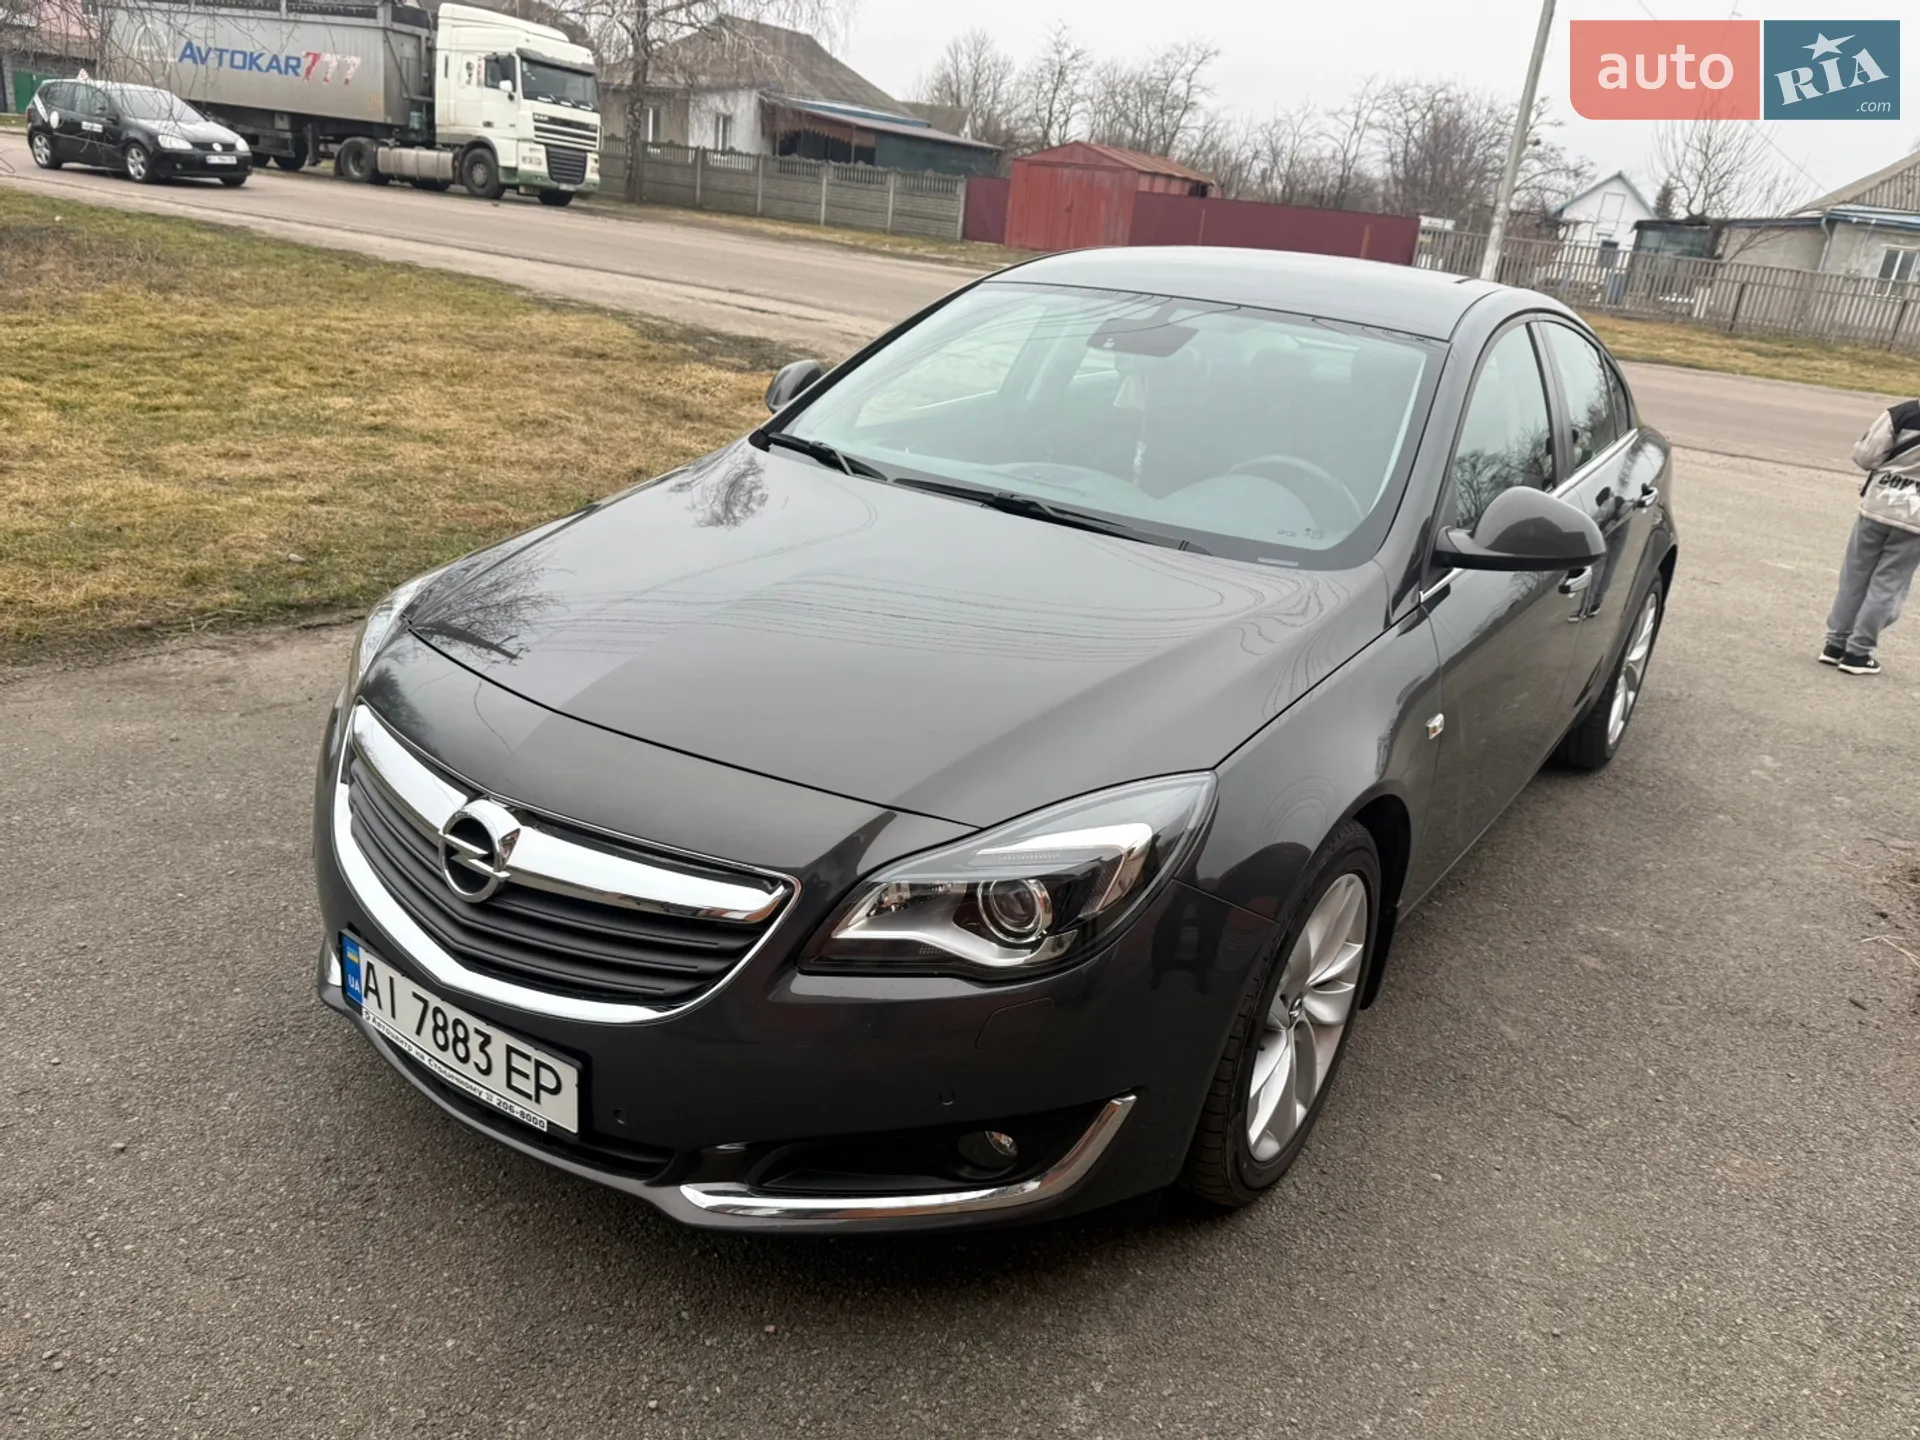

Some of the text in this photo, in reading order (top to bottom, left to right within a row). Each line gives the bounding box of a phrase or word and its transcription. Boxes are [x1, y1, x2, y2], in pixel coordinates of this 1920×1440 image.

[347, 973, 361, 993] UA
[363, 961, 563, 1105] AI 7883 EP
[496, 1098, 546, 1130] 206-8000
